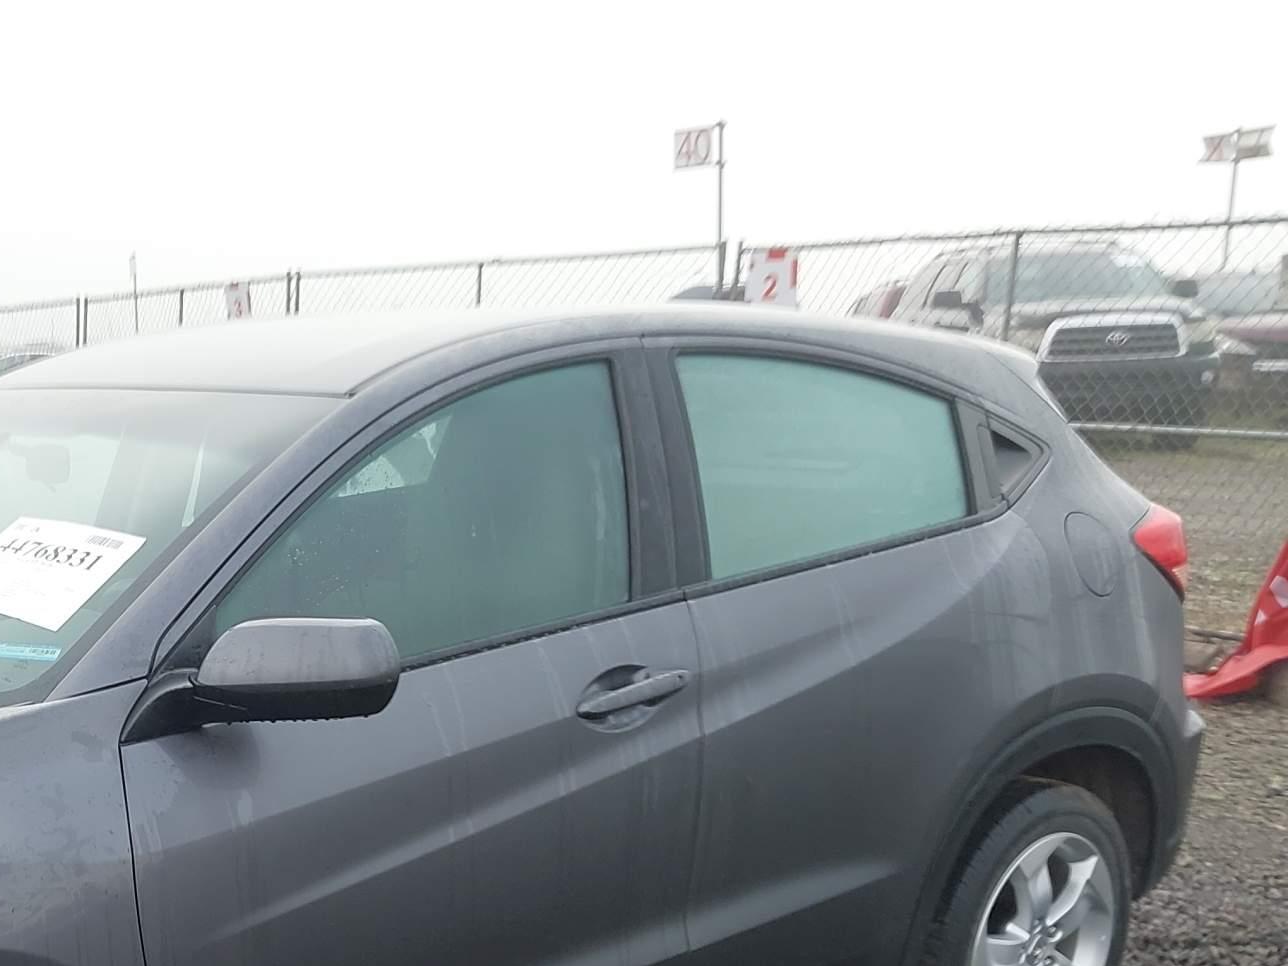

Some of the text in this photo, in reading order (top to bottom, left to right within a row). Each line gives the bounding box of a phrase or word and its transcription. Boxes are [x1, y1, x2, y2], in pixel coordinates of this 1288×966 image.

[675, 129, 712, 165] 40
[763, 273, 778, 301] 2
[0, 538, 103, 570] 44768331
